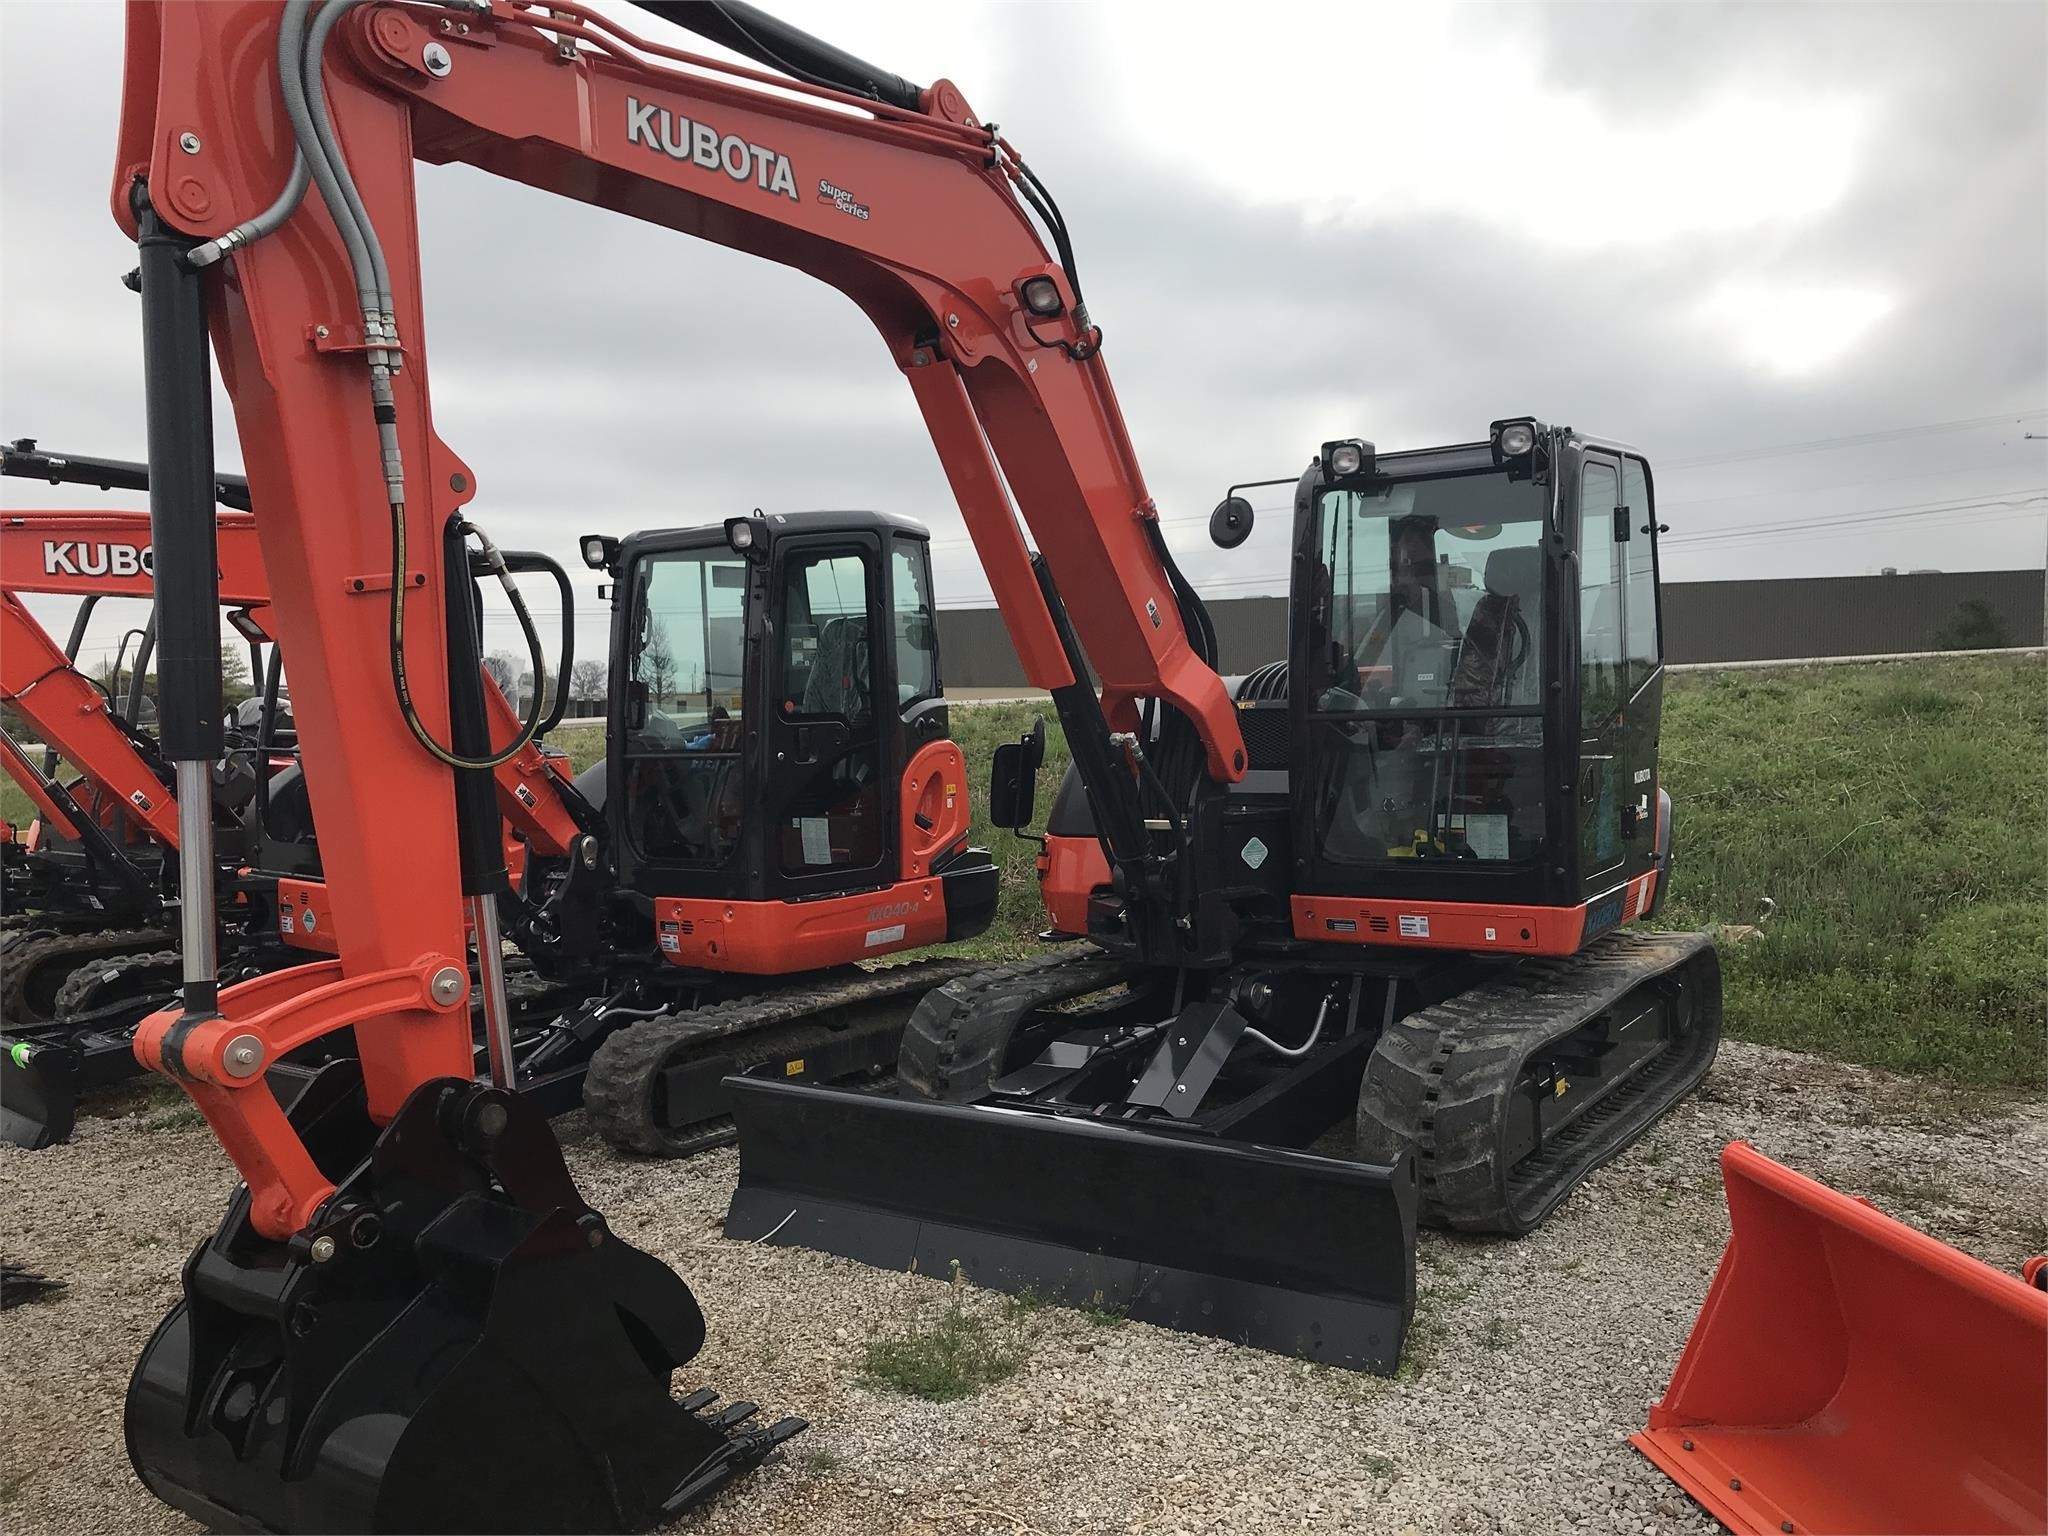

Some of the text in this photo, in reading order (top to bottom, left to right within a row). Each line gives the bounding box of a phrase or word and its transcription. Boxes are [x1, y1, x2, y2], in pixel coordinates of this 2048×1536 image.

[627, 96, 799, 200] KUBOTA
[819, 180, 853, 201] Super
[835, 198, 869, 220] Series
[44, 541, 154, 576] KUB
